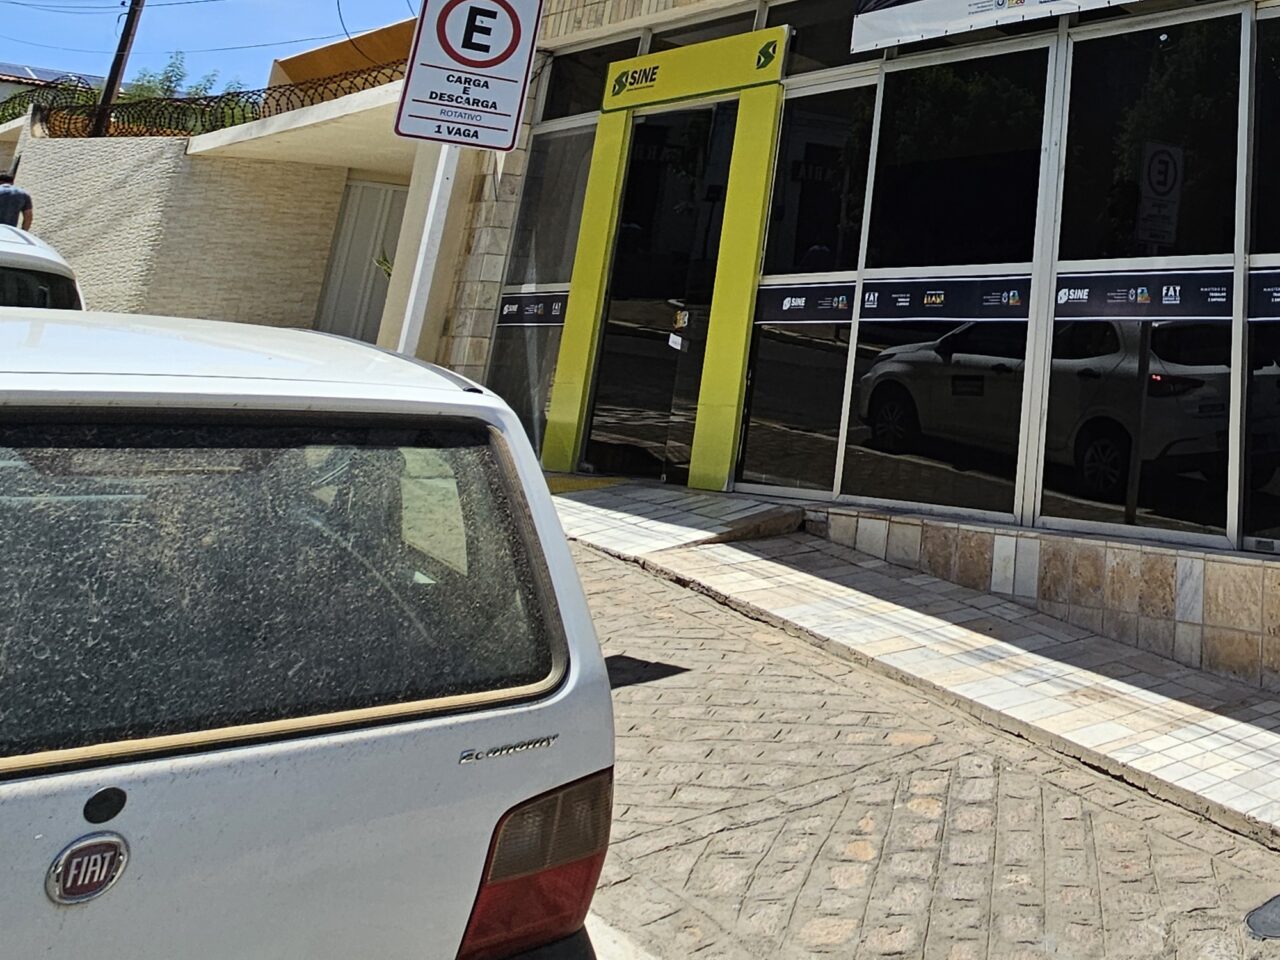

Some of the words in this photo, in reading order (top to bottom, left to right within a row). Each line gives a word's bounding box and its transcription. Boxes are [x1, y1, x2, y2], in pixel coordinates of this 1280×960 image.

[461, 5, 498, 54] E
[446, 74, 490, 89] CARGA
[462, 86, 471, 96] E
[428, 91, 498, 111] DESCARGA
[439, 108, 482, 122] ROTATIVO
[434, 124, 442, 134] 1
[446, 126, 480, 139] VAGA
[1068, 288, 1090, 300] SINE
[1162, 286, 1180, 297] FAT
[458, 733, 560, 765] Economy
[65, 851, 116, 889] FIAT
